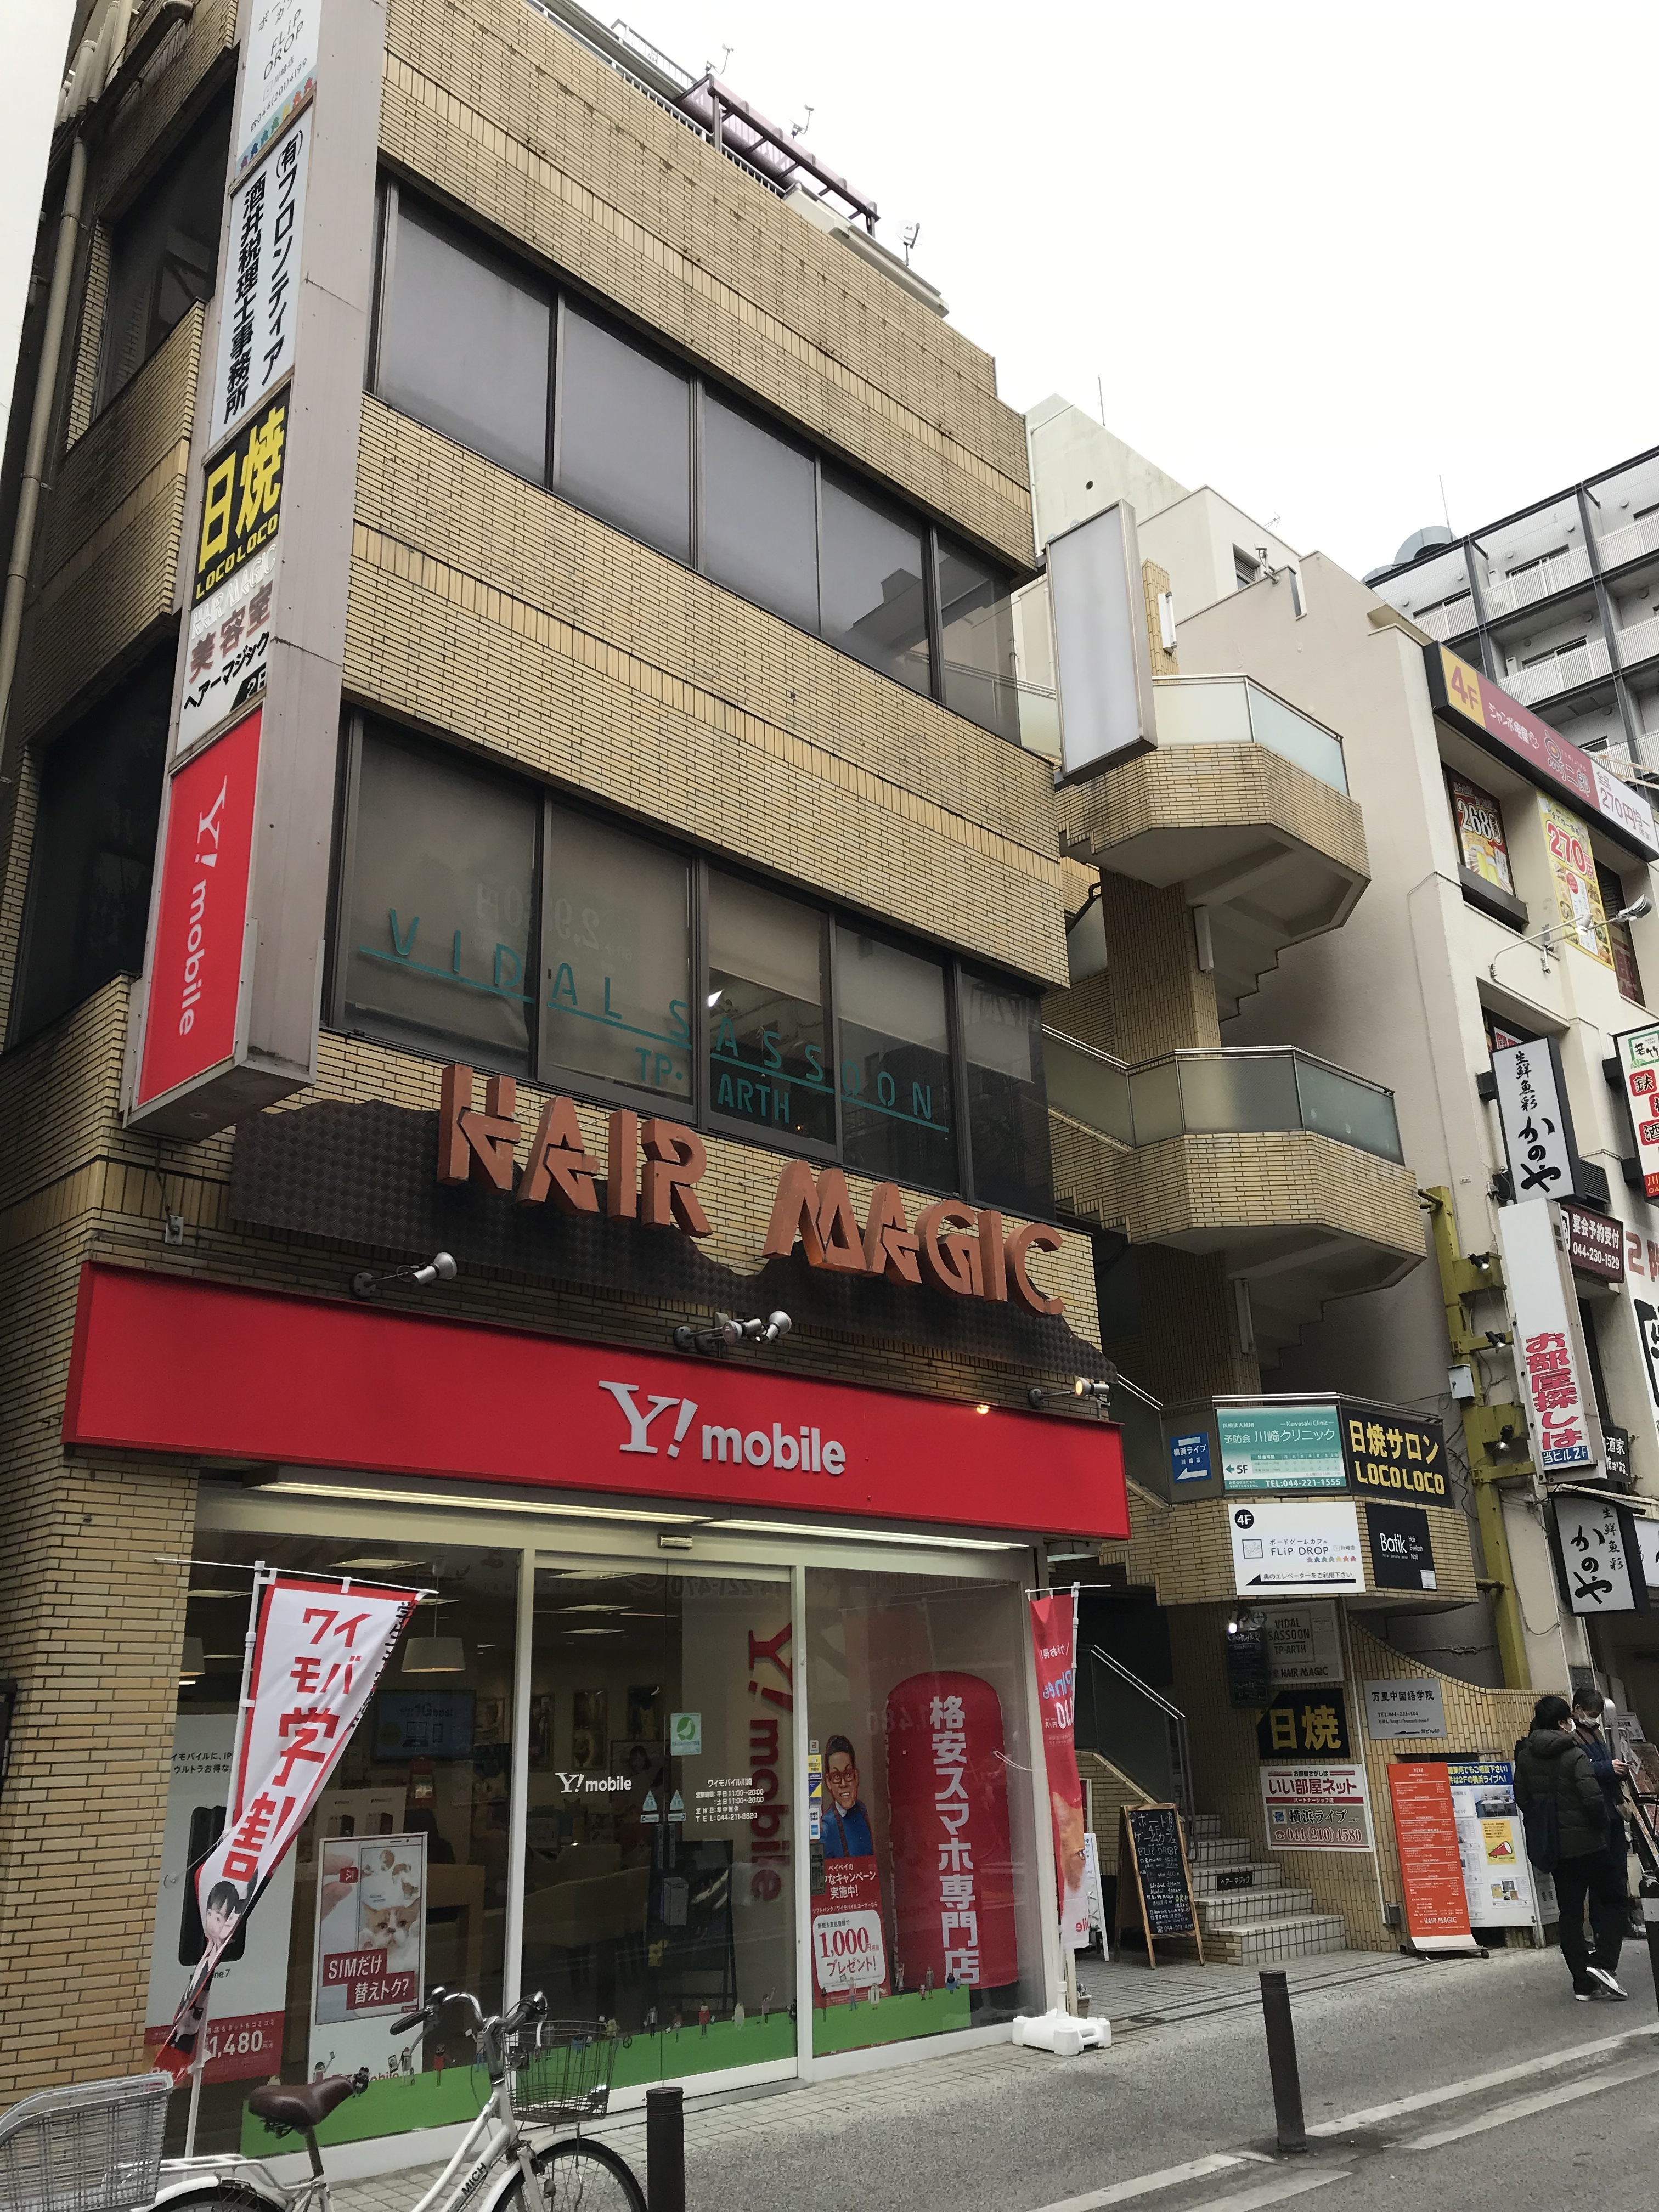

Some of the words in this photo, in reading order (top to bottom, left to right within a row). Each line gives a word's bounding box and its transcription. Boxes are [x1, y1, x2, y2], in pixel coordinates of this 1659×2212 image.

[263, 21, 303, 81] DROP
[224, 171, 267, 424] 酒井税理士事務所
[198, 406, 285, 573] 日焼
[189, 579, 273, 685] 美容室
[184, 631, 270, 709] ヘアーマジック
[1451, 665, 1479, 710] 4F
[390, 909, 622, 1020] VIDAL
[669, 999, 932, 1119] SASSOON
[1515, 1051, 1538, 1112] 生鮮魚彩
[1518, 1116, 1562, 1193] かのや
[438, 1064, 713, 1239] HAIR
[763, 1160, 1065, 1317] MAGIC
[1572, 1214, 1620, 1249] 宴会予約受付
[1573, 1241, 1620, 1270] 044-230-1529
[1525, 1332, 1583, 1451] お部屋探しは
[1173, 1444, 1207, 1457] 横浜ライブ
[1224, 1434, 1251, 1444] 予防会
[1255, 1429, 1335, 1443] 川崎クリニック
[1348, 1419, 1440, 1465] 日焼サロン
[1603, 1436, 1626, 1455] 酒家
[1237, 1465, 1248, 1474] 5F
[1543, 1447, 1589, 1466] 当ビル2F
[1237, 1514, 1252, 1525] 4F
[1299, 1547, 1329, 1555] DROP
[1380, 1532, 1407, 1554] Batik
[1570, 1525, 1613, 1605] かのや
[1268, 1628, 1310, 1641] SASSOON
[1274, 1618, 1301, 1629] VIDAL
[1371, 1690, 1435, 1702] 万里中国語学院
[1270, 1705, 1342, 1751] 日焼
[708, 1778, 753, 1787] ワイモバイル川崎
[1268, 1778, 1357, 1795] いい部屋ネット
[1289, 1808, 1348, 1824] 横浜ライブ
[930, 1695, 980, 1986] 格安スマホ専門店
[328, 1954, 383, 1979] SIMだけ
